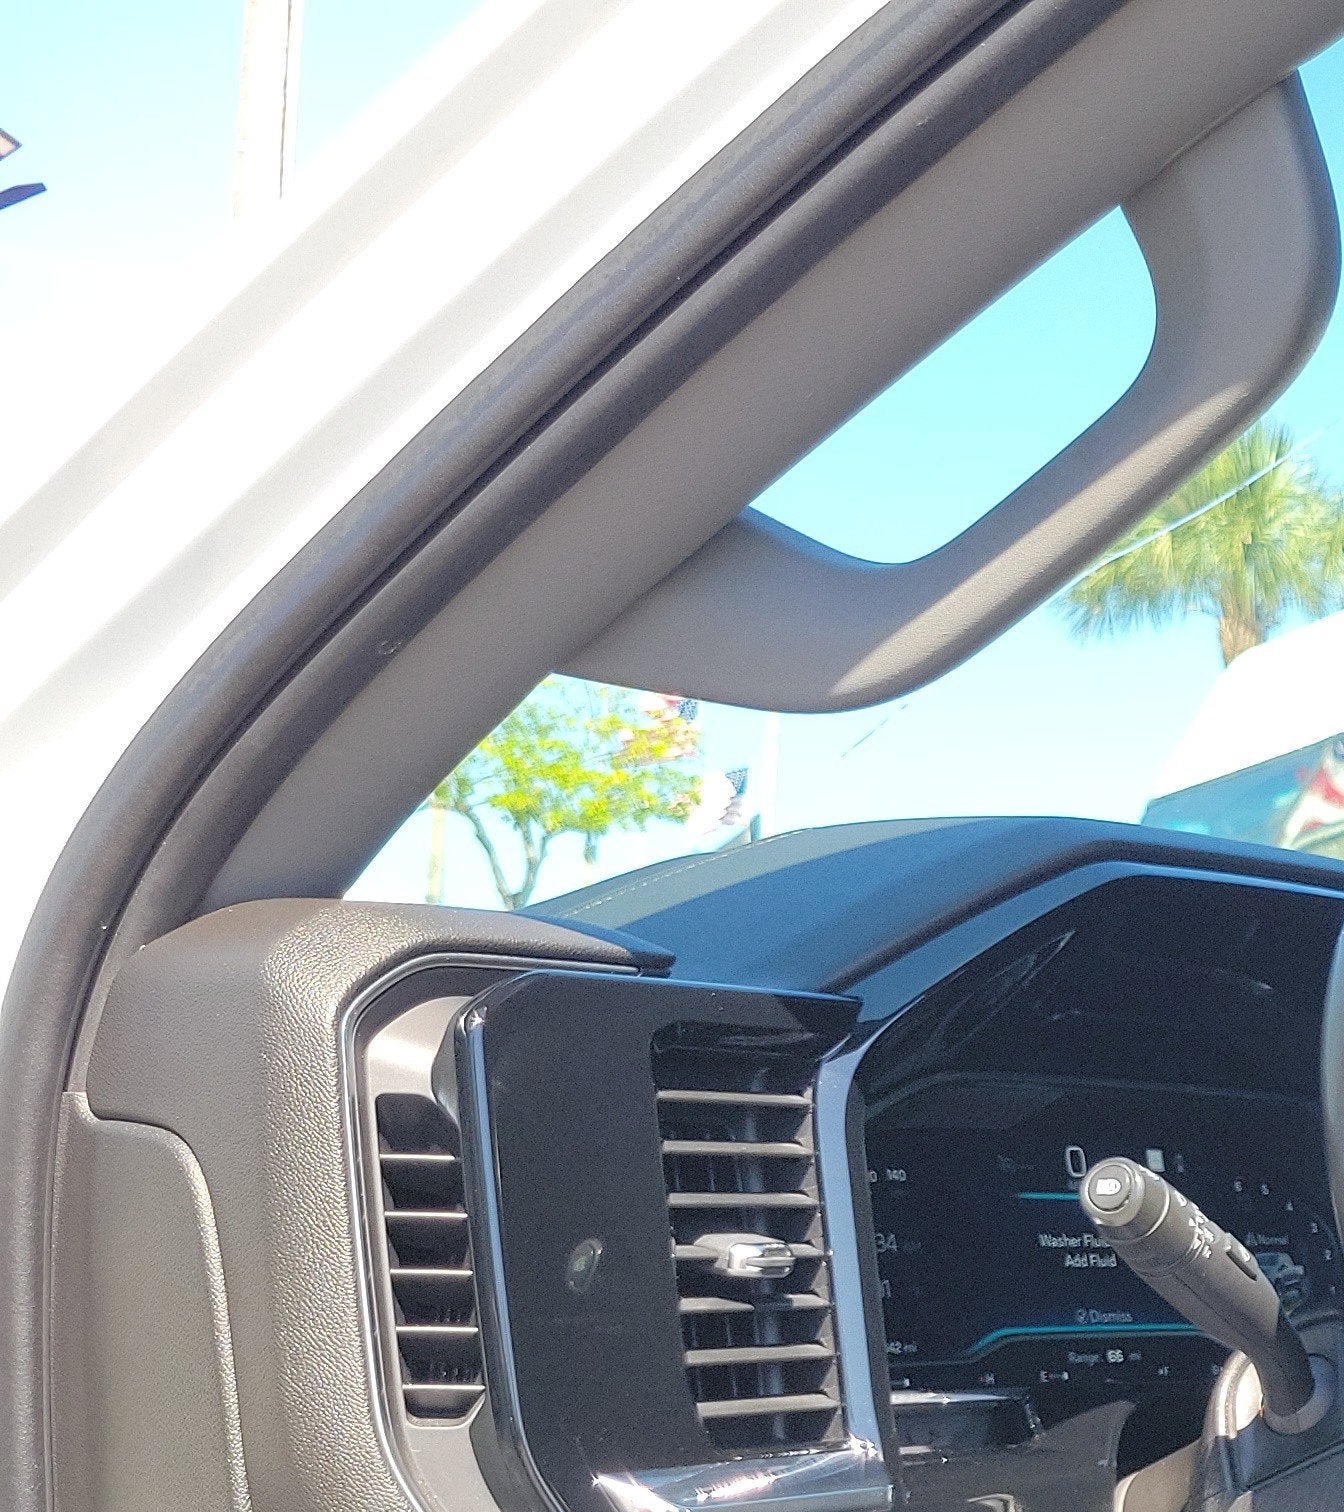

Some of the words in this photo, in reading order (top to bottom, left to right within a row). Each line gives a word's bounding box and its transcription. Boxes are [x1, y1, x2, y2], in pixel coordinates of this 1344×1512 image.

[1064, 1146, 1087, 1178] 0
[1039, 1233, 1081, 1248] Washer
[1065, 1254, 1087, 1268] Add
[1089, 1253, 1117, 1268] Fluid
